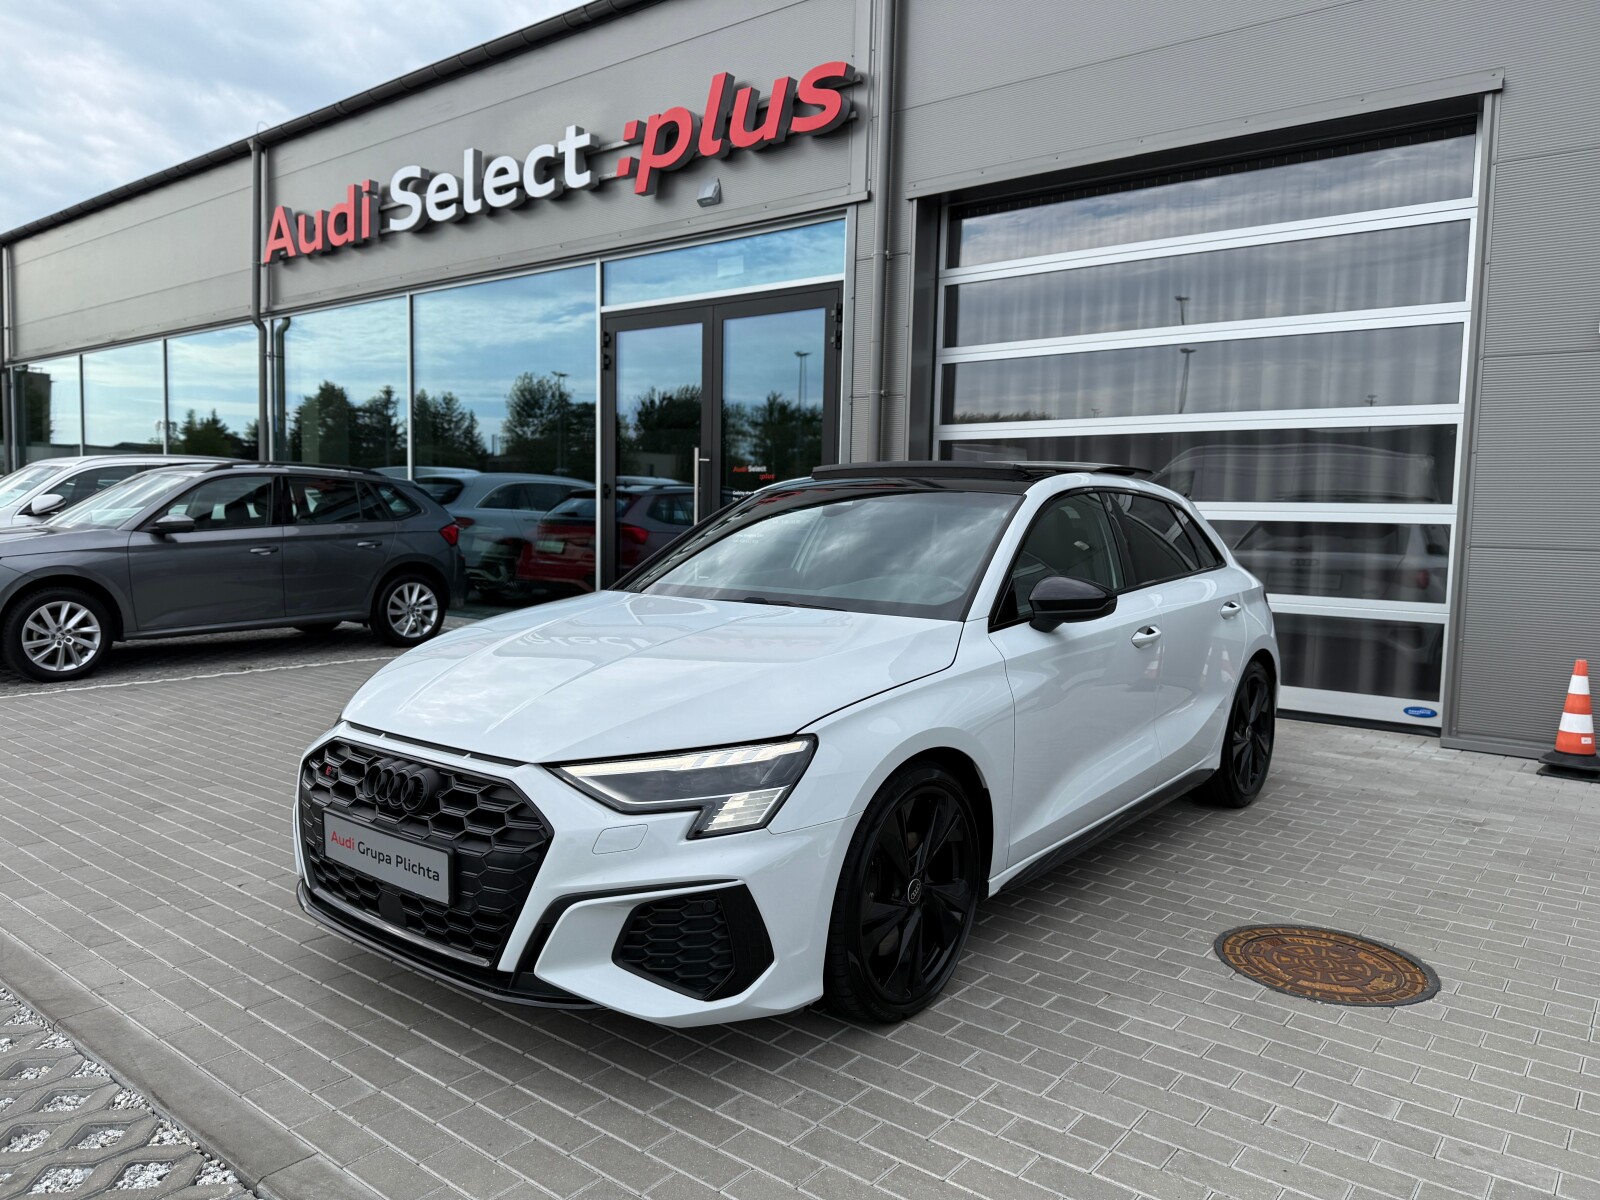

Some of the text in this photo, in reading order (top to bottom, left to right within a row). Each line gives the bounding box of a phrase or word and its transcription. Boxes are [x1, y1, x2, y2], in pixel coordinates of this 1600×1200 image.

[263, 178, 378, 264] Audi
[389, 124, 597, 231] Select
[331, 830, 440, 882] Audi Grupa Plichta
